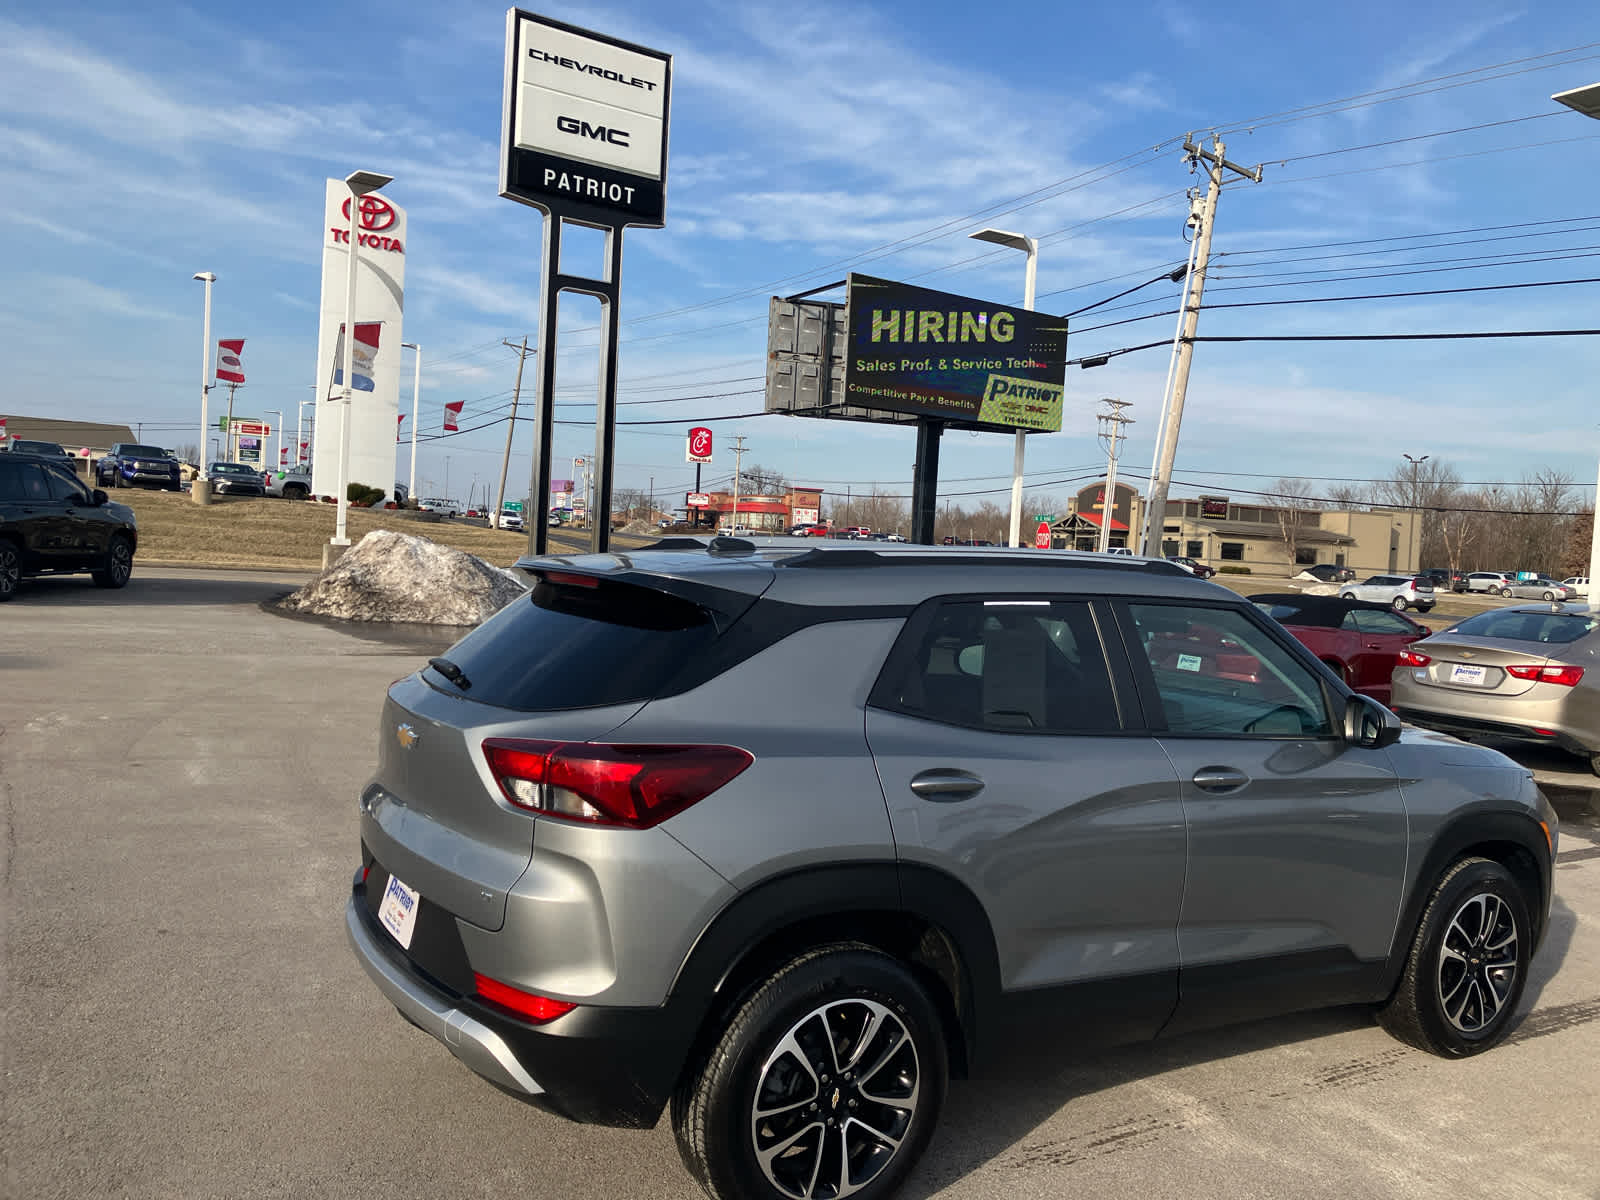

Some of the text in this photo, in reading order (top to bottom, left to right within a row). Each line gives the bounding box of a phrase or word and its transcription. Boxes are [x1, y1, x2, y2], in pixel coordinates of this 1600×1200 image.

[528, 48, 657, 91] CHEVROLET
[556, 115, 630, 147] GMC
[544, 168, 635, 204] PATRIOT
[330, 228, 402, 253] TOYOTA
[871, 308, 1016, 343] HIRING
[855, 359, 896, 372] Sales
[900, 358, 933, 371] Prof.
[938, 359, 948, 370] &
[952, 357, 1002, 370] Service
[848, 383, 908, 400] Competitive
[910, 392, 928, 404] Pay
[937, 396, 975, 410] Benefits
[988, 378, 1061, 403] PATRIOT
[1036, 533, 1050, 545] STOP
[387, 877, 414, 912] PATRIOT
